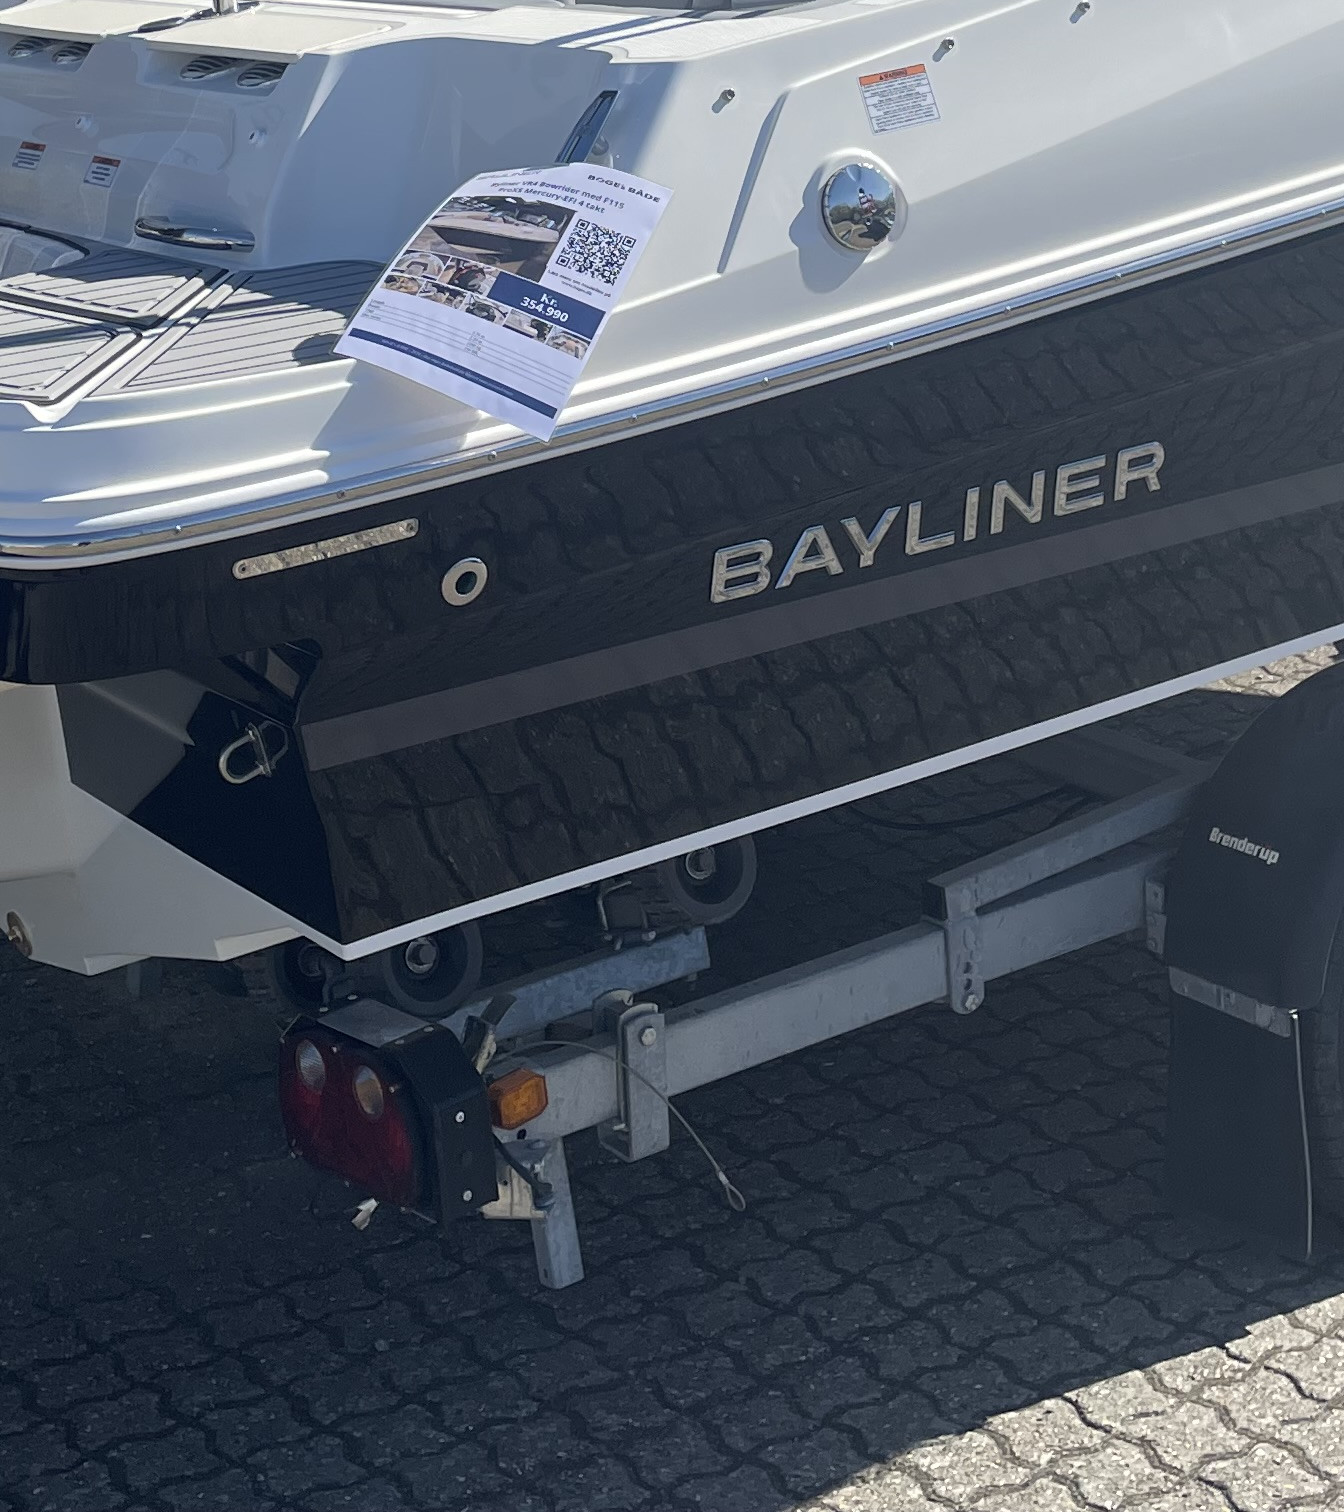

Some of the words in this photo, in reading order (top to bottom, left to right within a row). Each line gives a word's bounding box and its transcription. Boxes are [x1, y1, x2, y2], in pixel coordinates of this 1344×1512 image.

[520, 296, 569, 323] 354.990
[540, 292, 558, 308] Kr.
[709, 441, 1166, 604] BAYLINER
[1209, 827, 1280, 865] Brenderup
